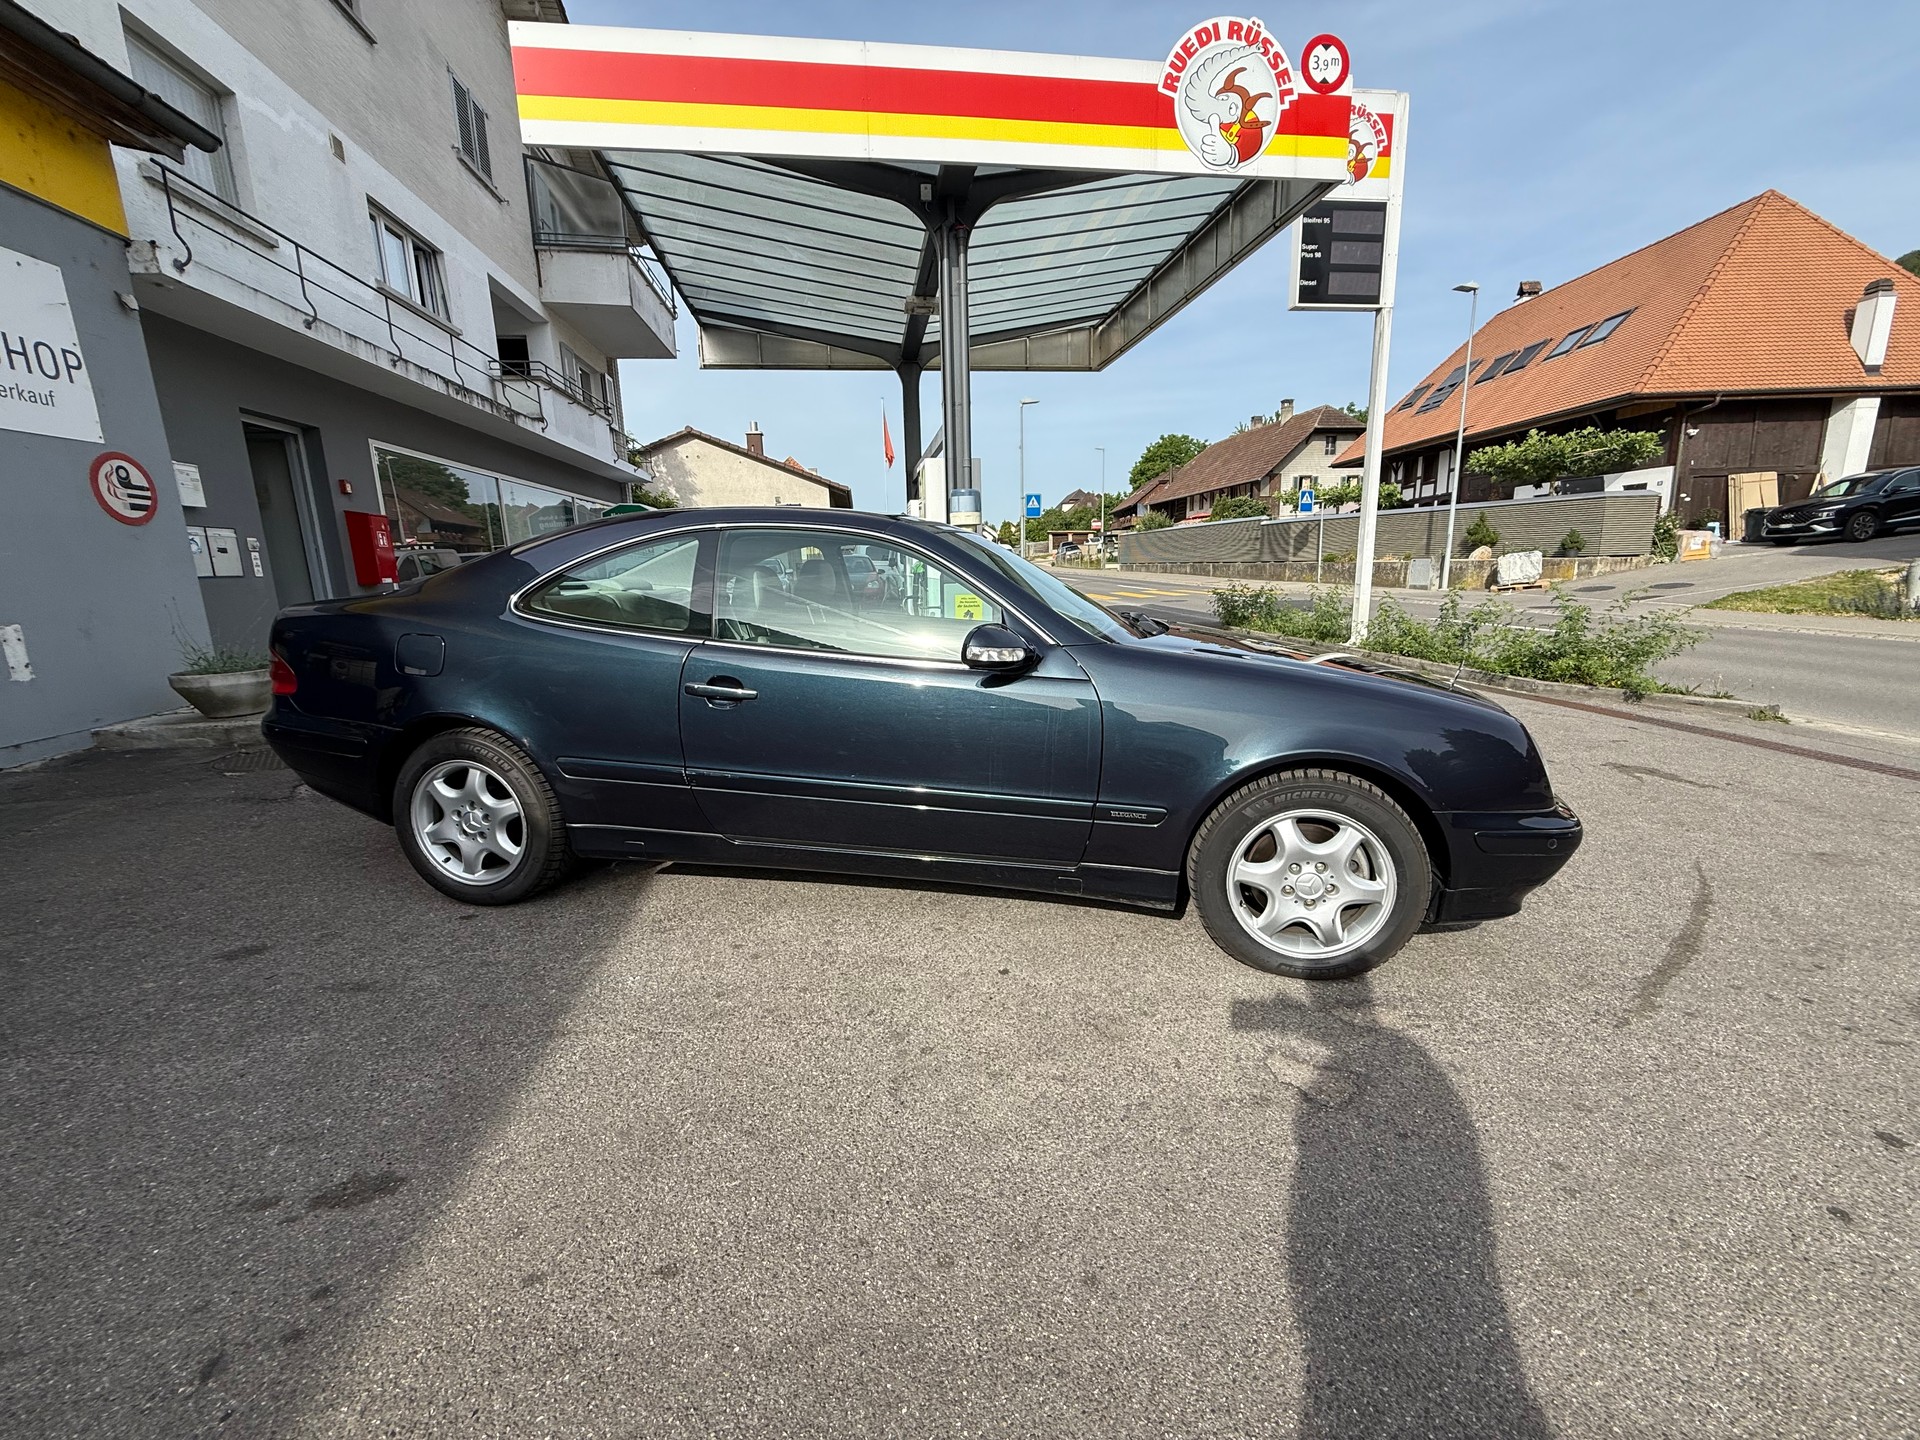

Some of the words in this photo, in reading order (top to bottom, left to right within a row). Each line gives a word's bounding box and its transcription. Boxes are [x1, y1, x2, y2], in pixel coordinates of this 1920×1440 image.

[1162, 22, 1221, 93] RUEDI
[1227, 20, 1294, 105] RÜSSEL
[1312, 55, 1329, 72] 3,9
[0, 330, 83, 384] HOP
[459, 743, 512, 771] MICHELIN
[1273, 790, 1345, 805] MICHELIN
[1110, 810, 1147, 819] ELEGANCE
